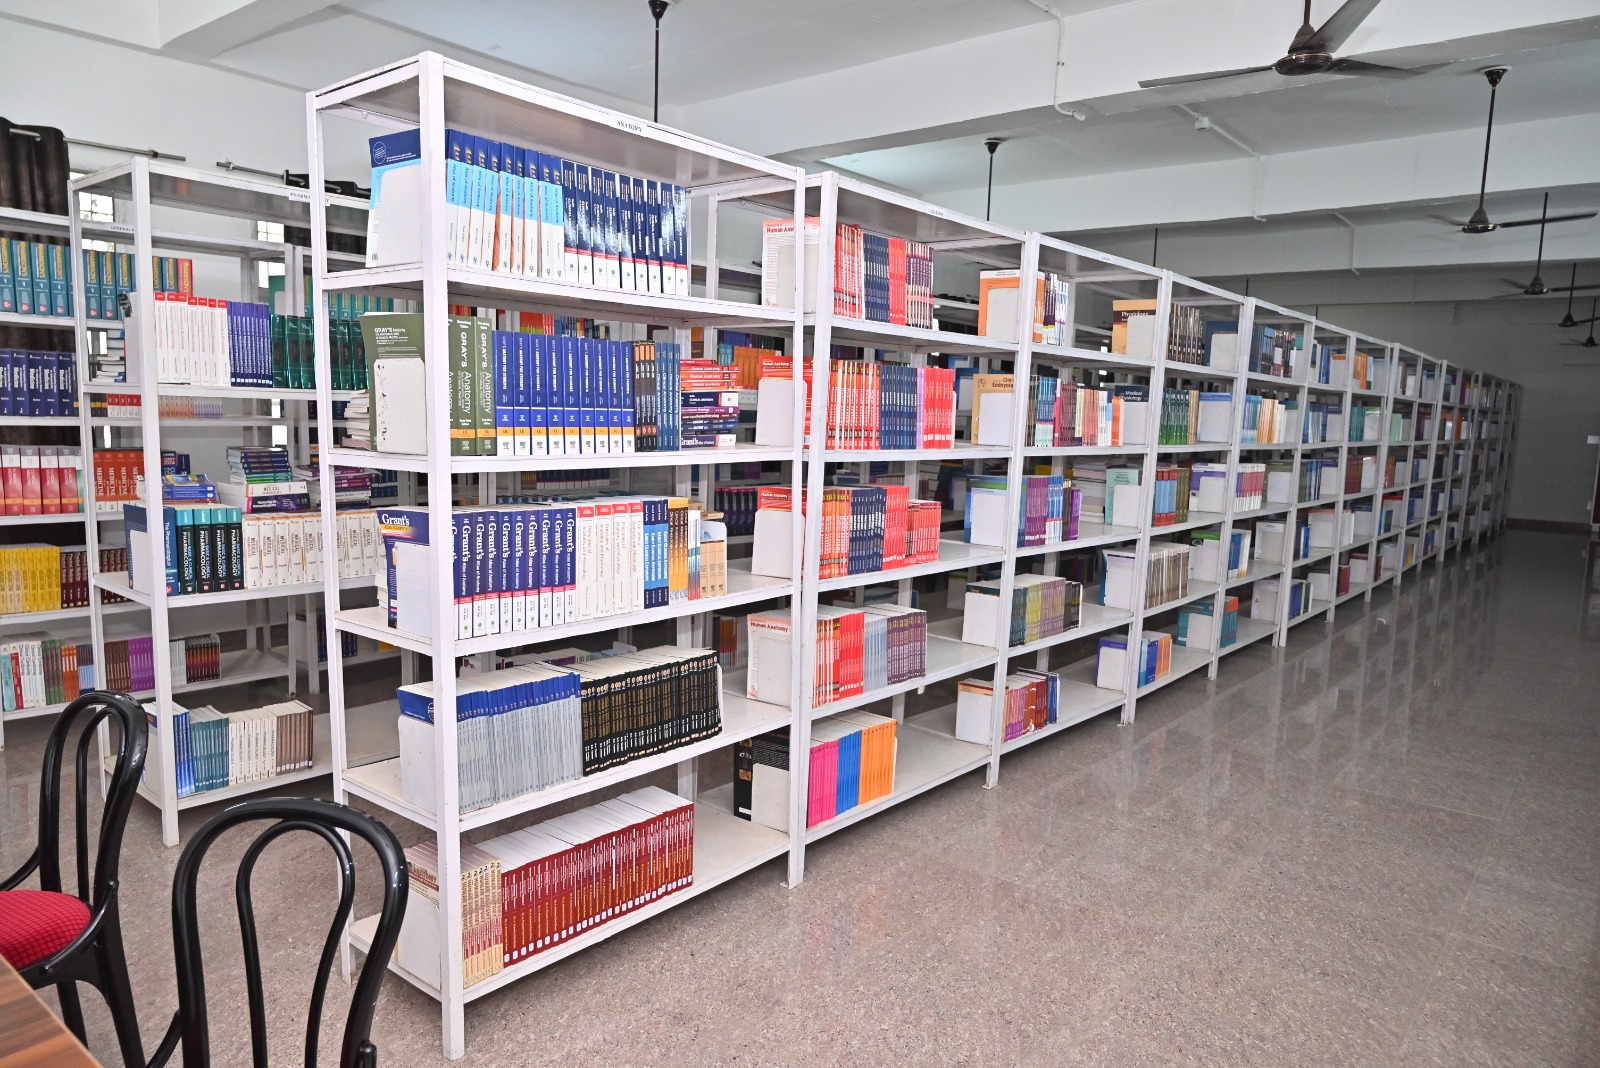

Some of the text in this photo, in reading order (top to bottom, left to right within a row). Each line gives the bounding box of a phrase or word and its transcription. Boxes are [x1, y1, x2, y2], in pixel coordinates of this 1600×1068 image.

[382, 514, 410, 526] Grant's
[463, 526, 471, 562] Grant's
[529, 522, 537, 556] Grant's
[767, 624, 788, 632] Anatomy
